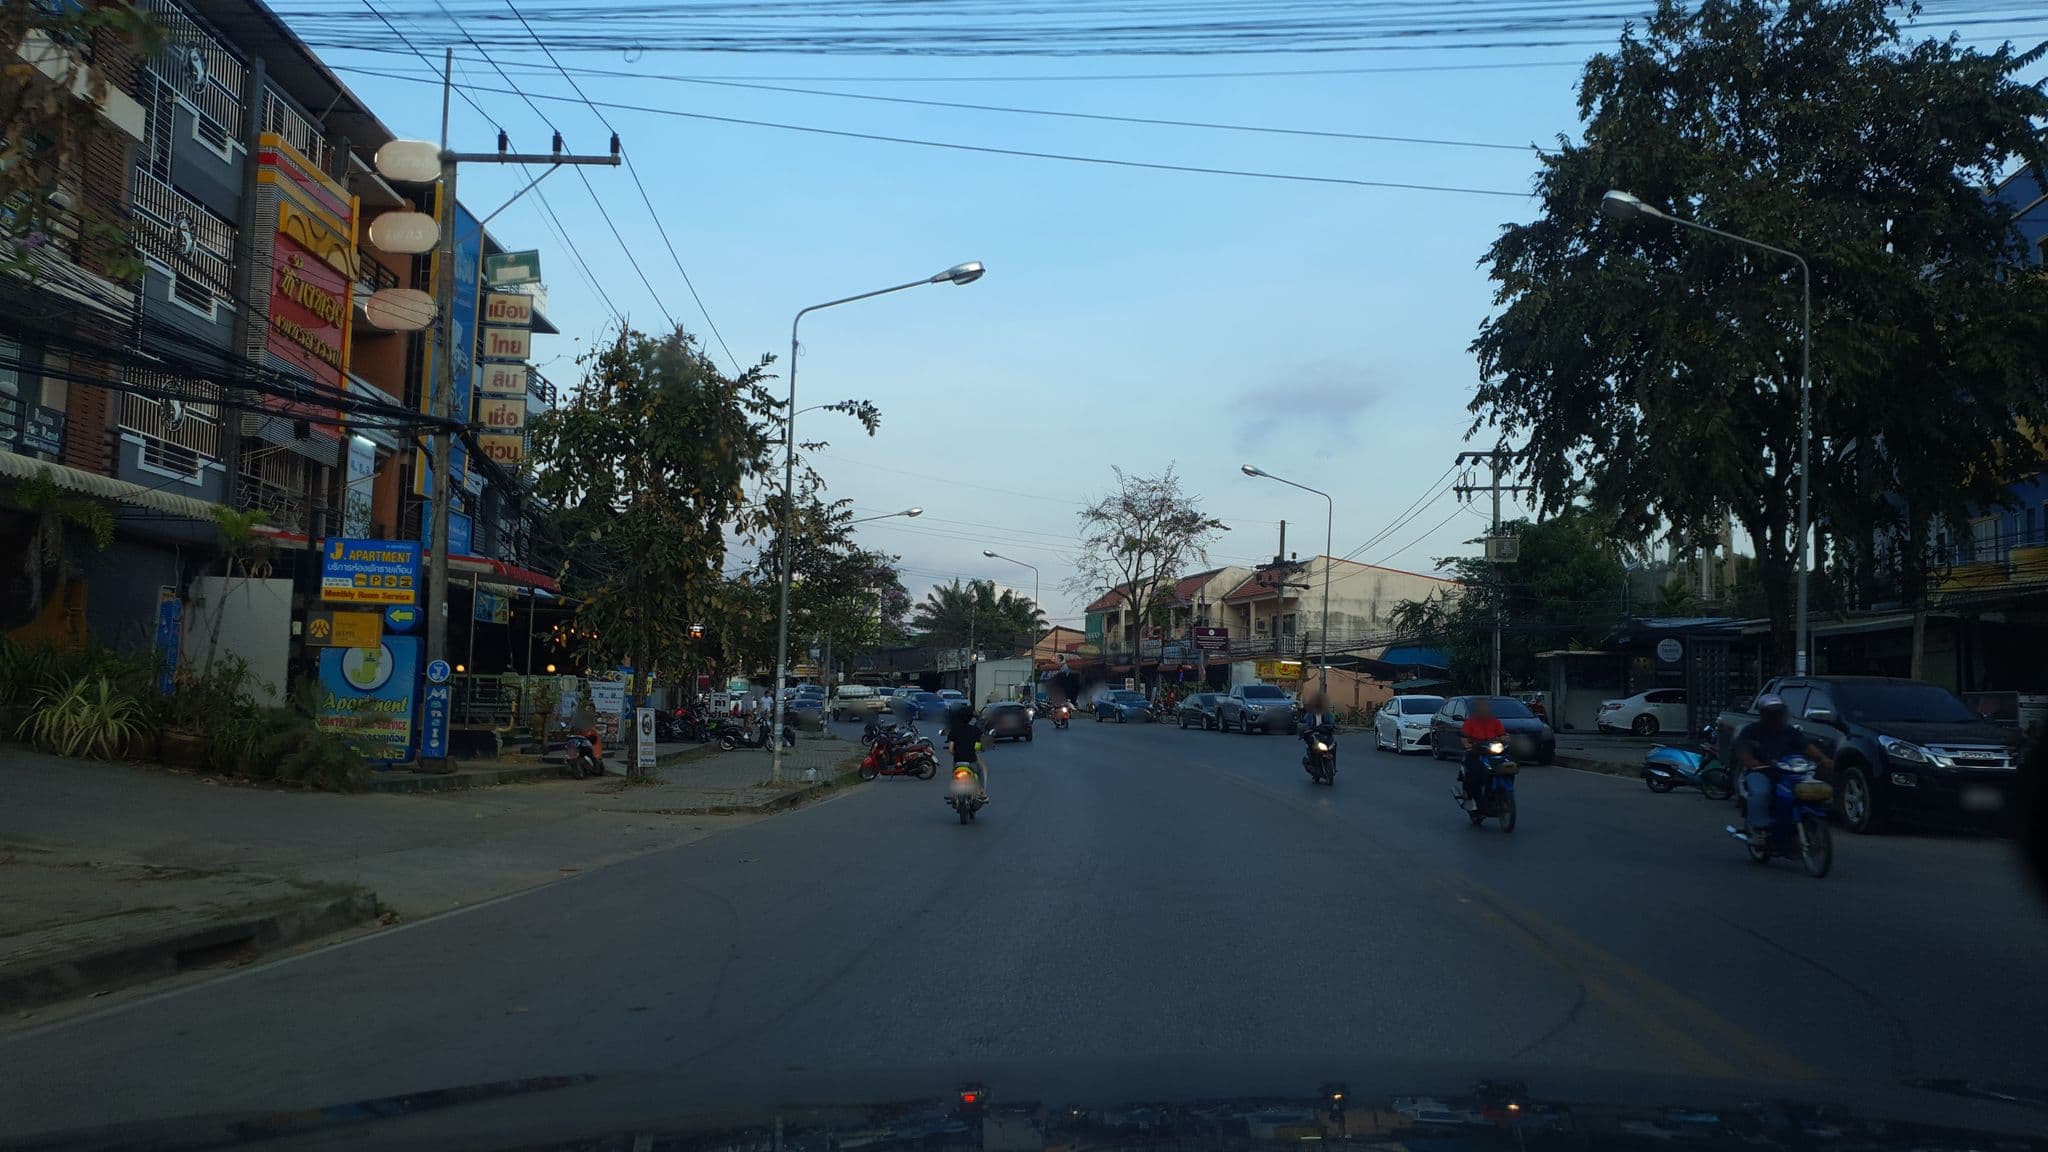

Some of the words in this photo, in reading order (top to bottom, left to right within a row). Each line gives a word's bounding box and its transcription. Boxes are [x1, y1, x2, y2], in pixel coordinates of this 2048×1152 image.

[490, 332, 522, 355] ไทย
[349, 549, 412, 563] APARTMENT
[327, 562, 413, 575] บริการห้องพักรายเดือน
[324, 589, 355, 600] Monthly
[358, 591, 380, 599] Room
[382, 591, 410, 600] Service
